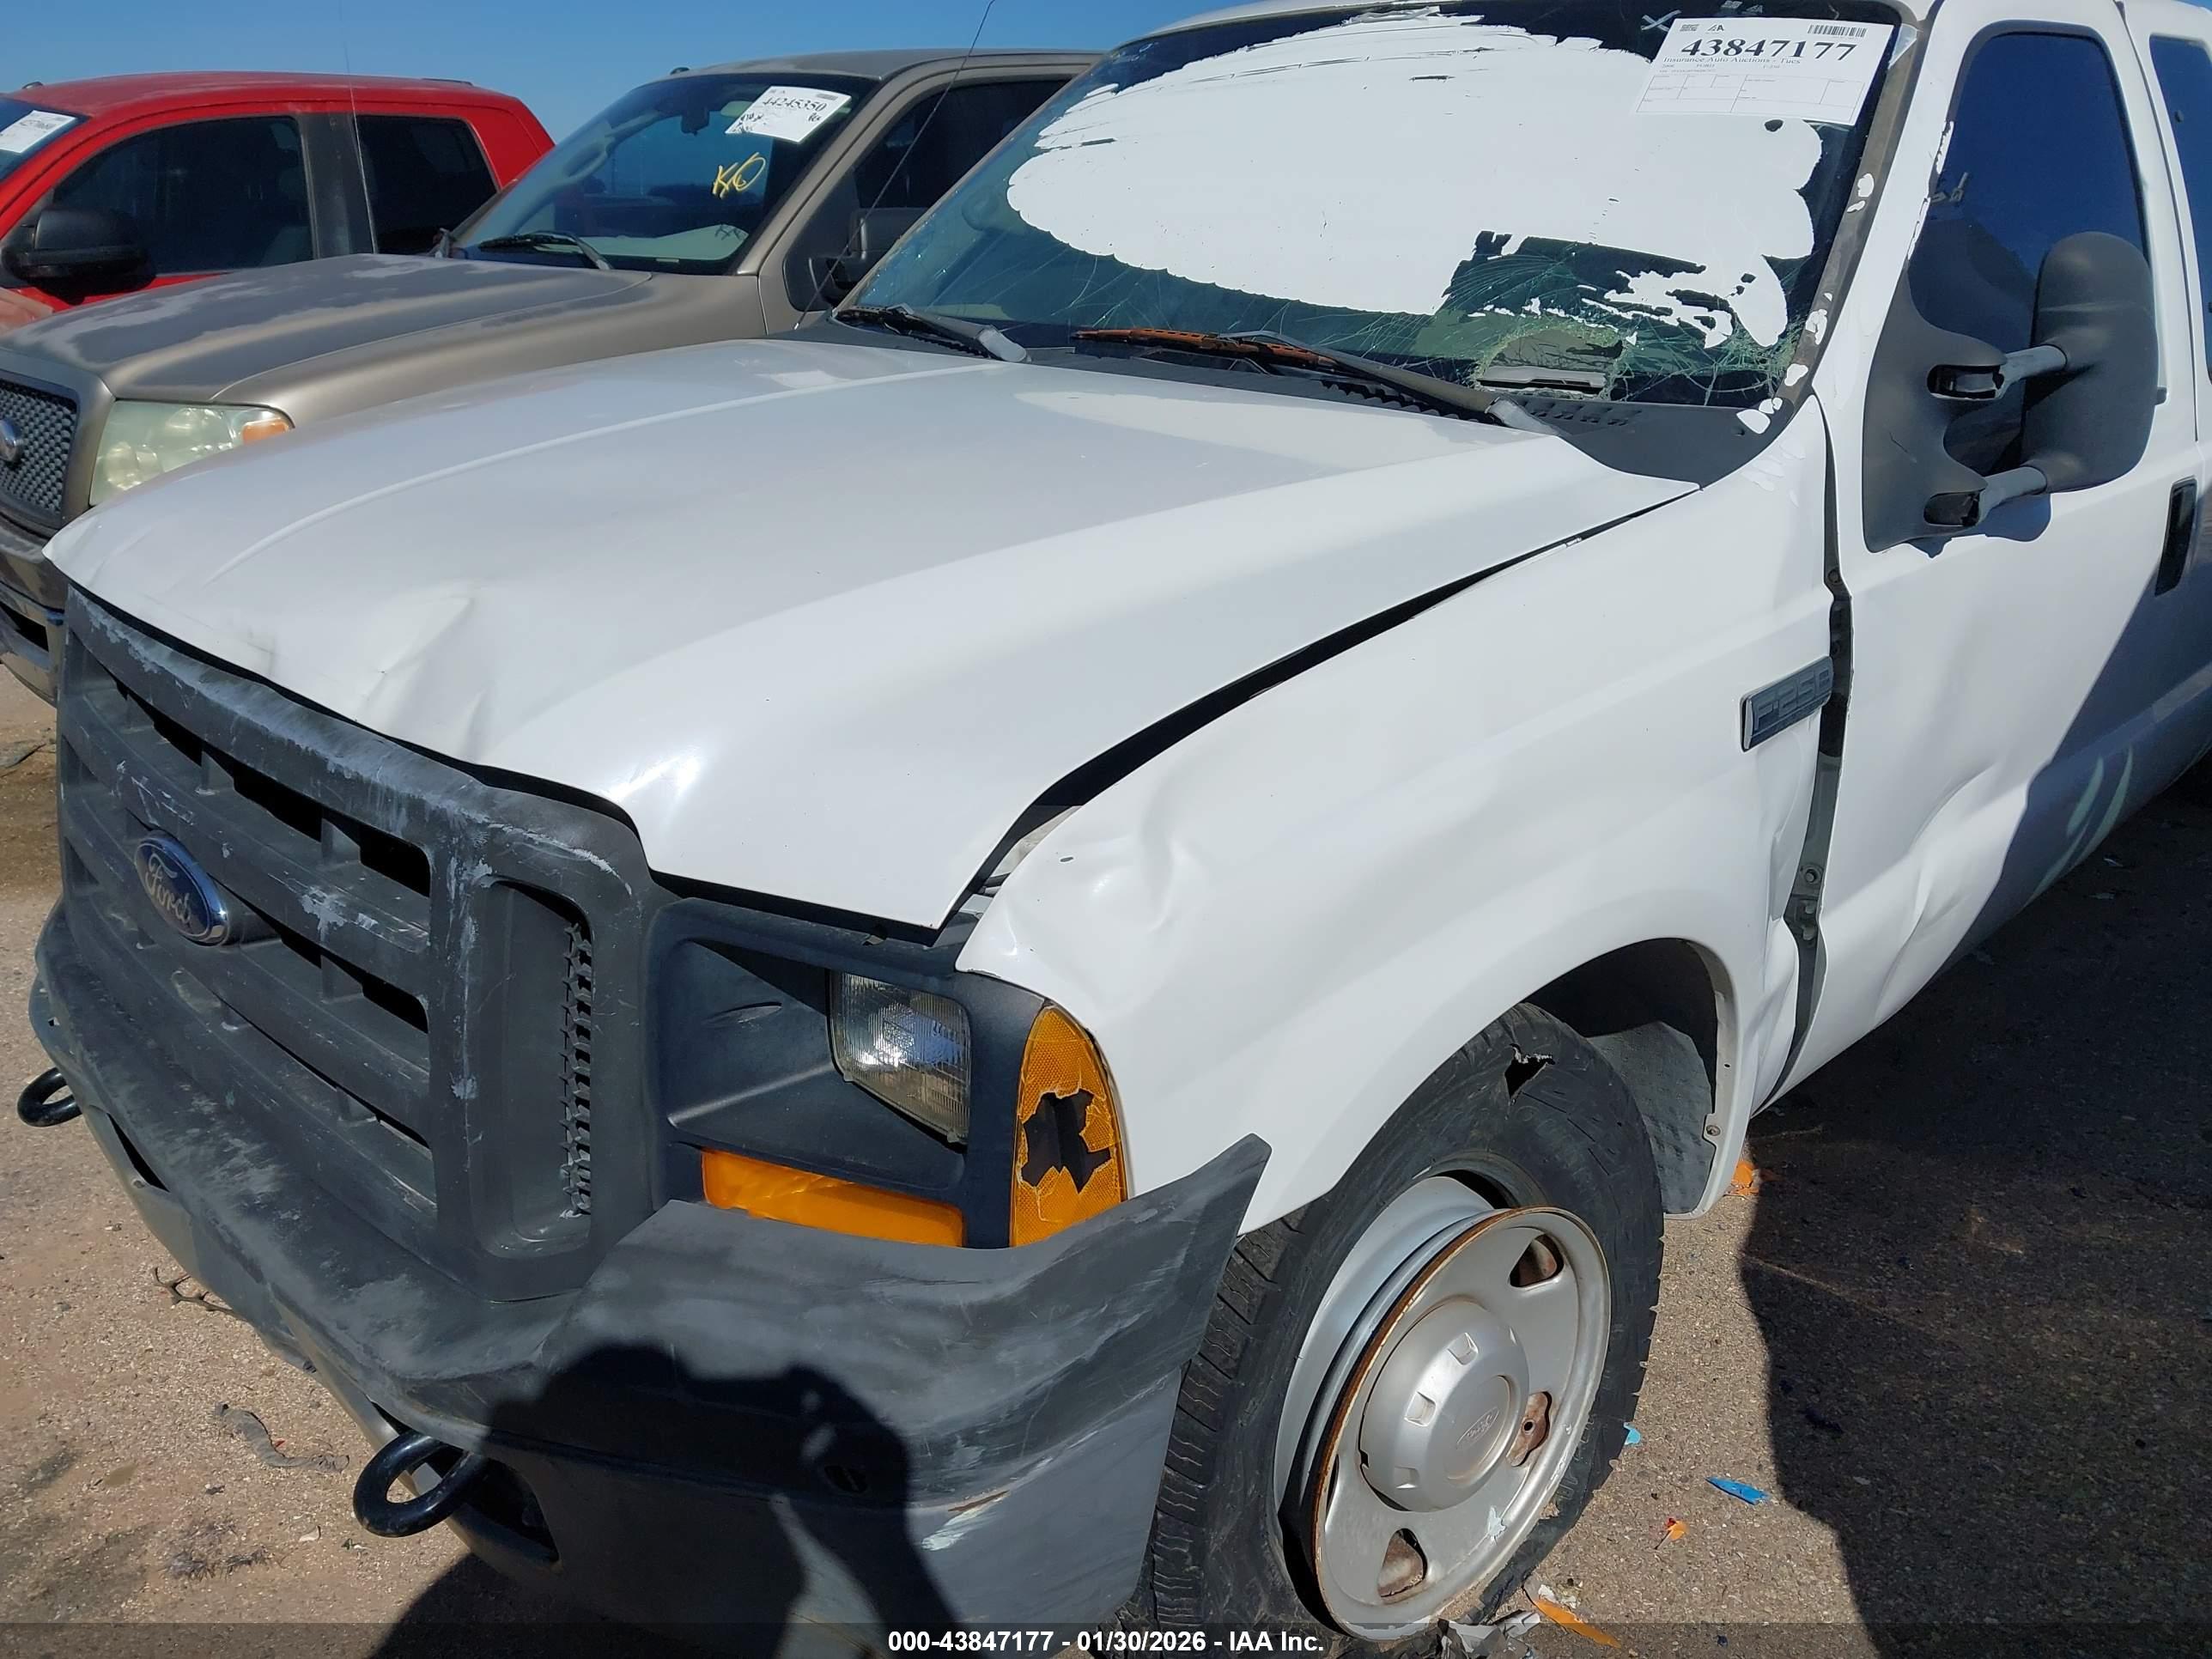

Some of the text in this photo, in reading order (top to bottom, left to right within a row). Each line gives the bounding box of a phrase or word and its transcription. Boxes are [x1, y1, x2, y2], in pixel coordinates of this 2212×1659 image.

[1680, 39, 1856, 61] 43847177
[762, 96, 828, 112] 44245350
[144, 853, 191, 925] Ford
